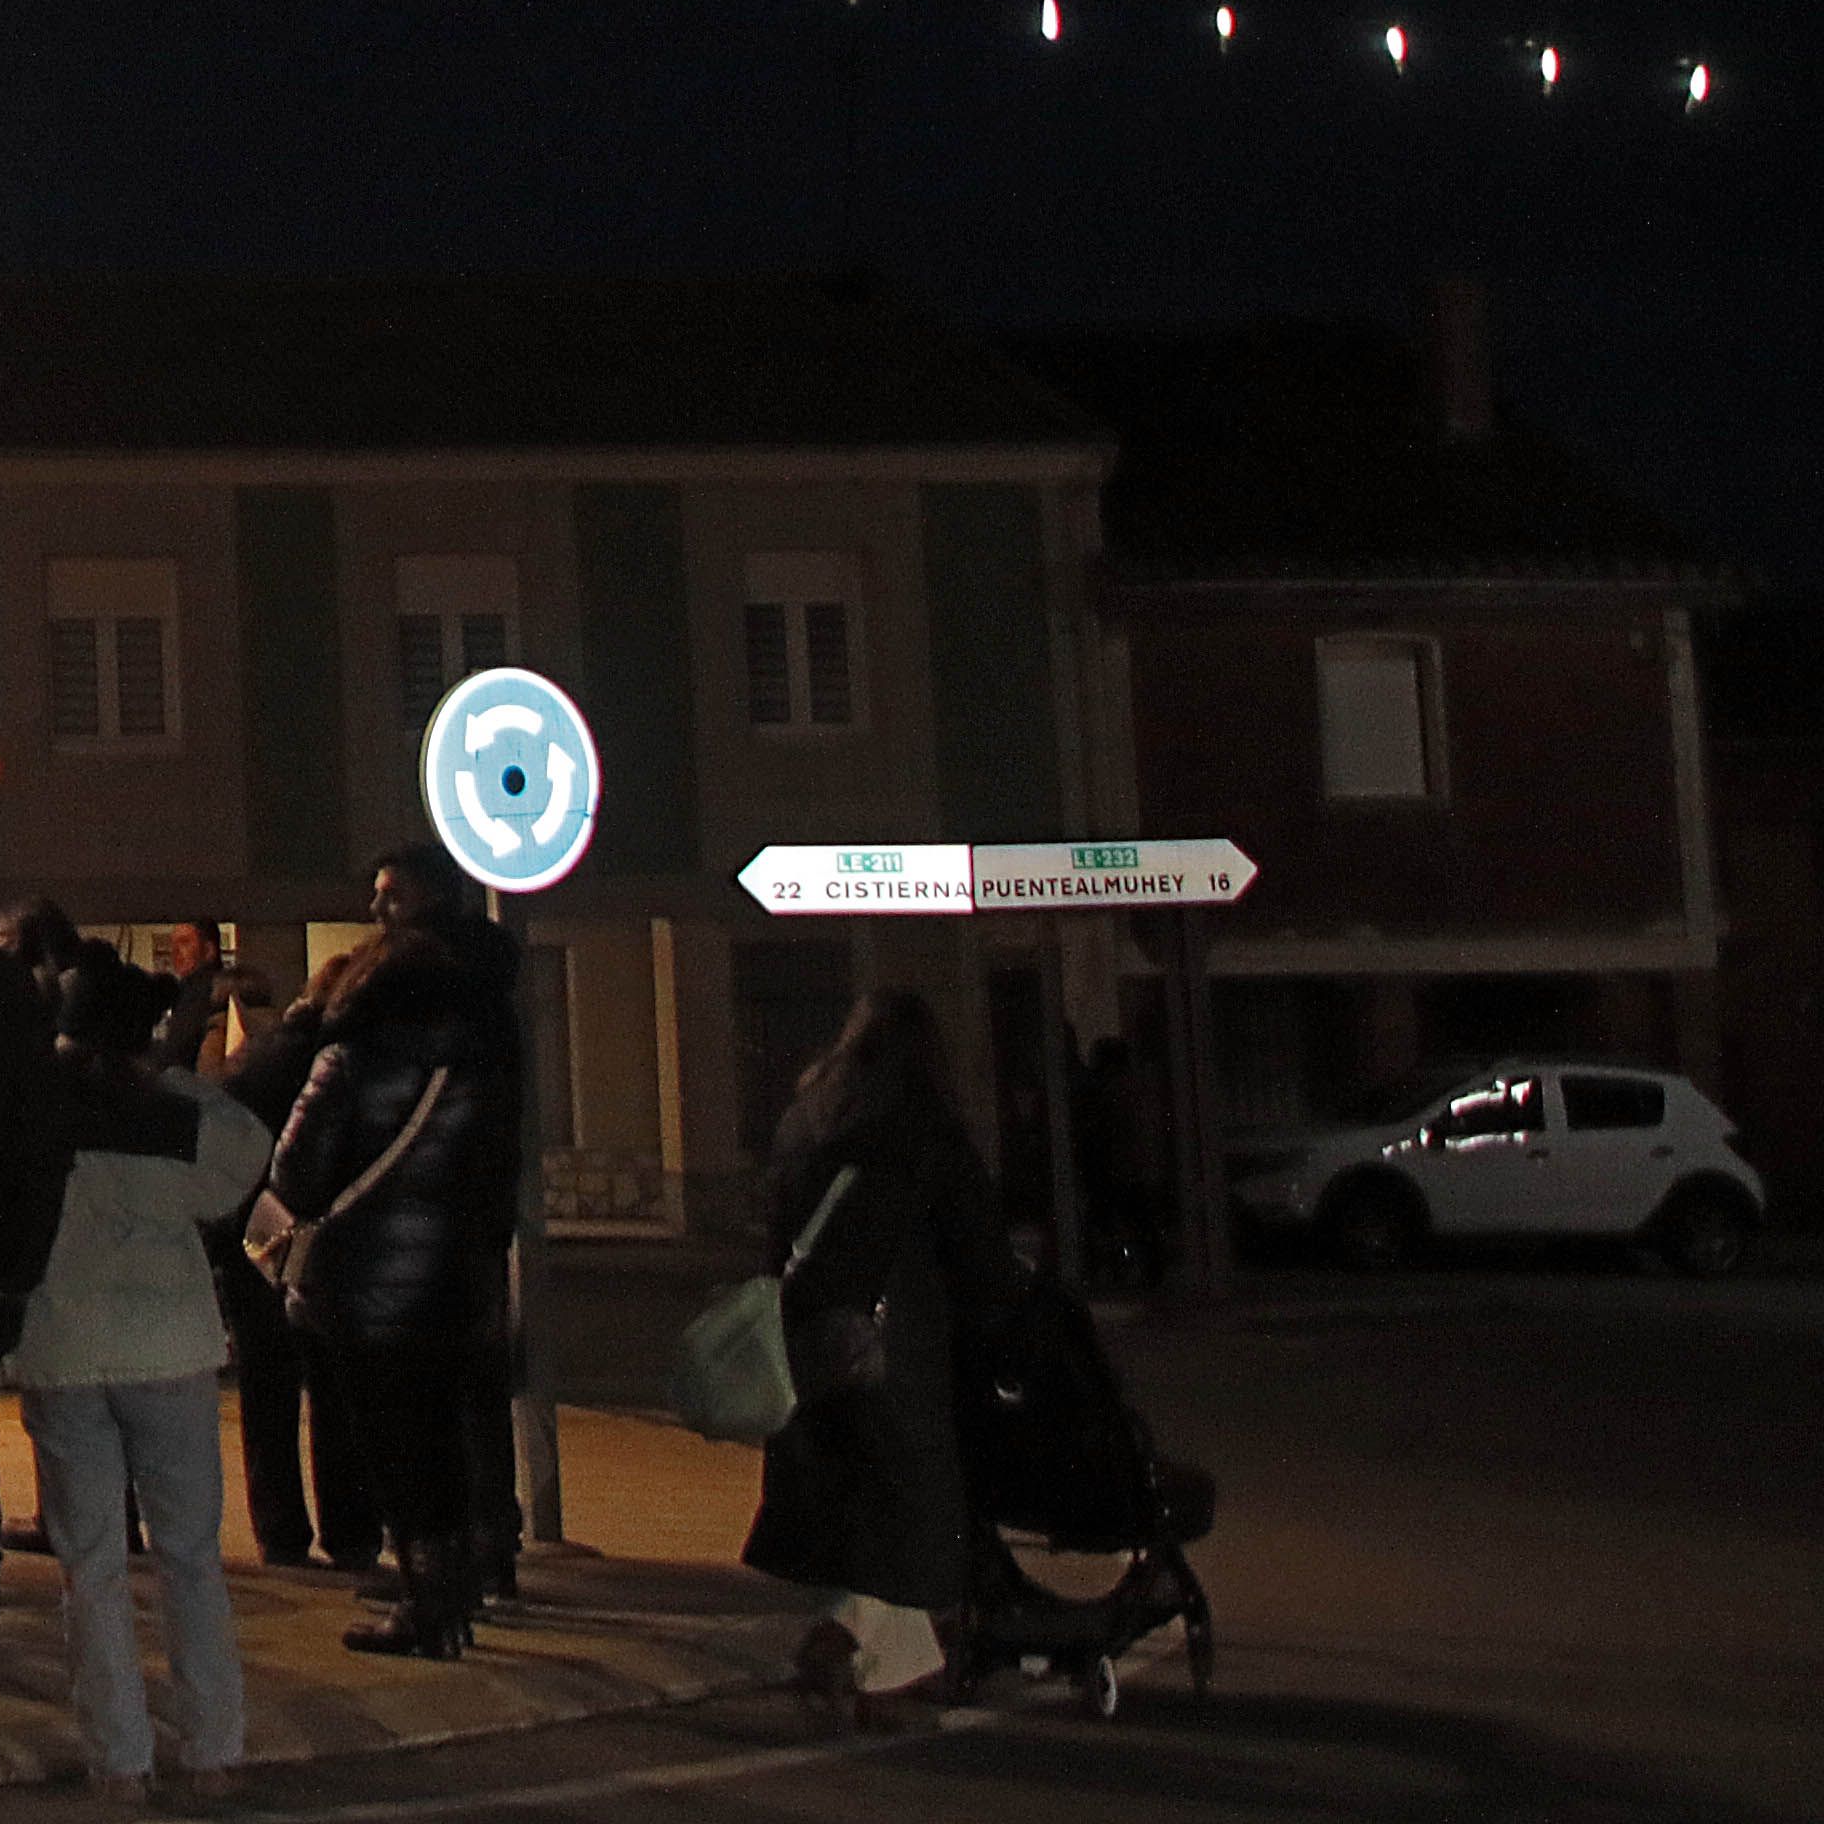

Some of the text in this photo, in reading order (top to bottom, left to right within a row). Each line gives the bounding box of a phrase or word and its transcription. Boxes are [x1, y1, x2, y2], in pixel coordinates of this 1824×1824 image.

[838, 854, 901, 872] LE-211
[1073, 848, 1135, 867] LE-232
[772, 880, 970, 900] 22 CISTIERNA
[983, 872, 1231, 898] PUENTEALMUHEY 16
